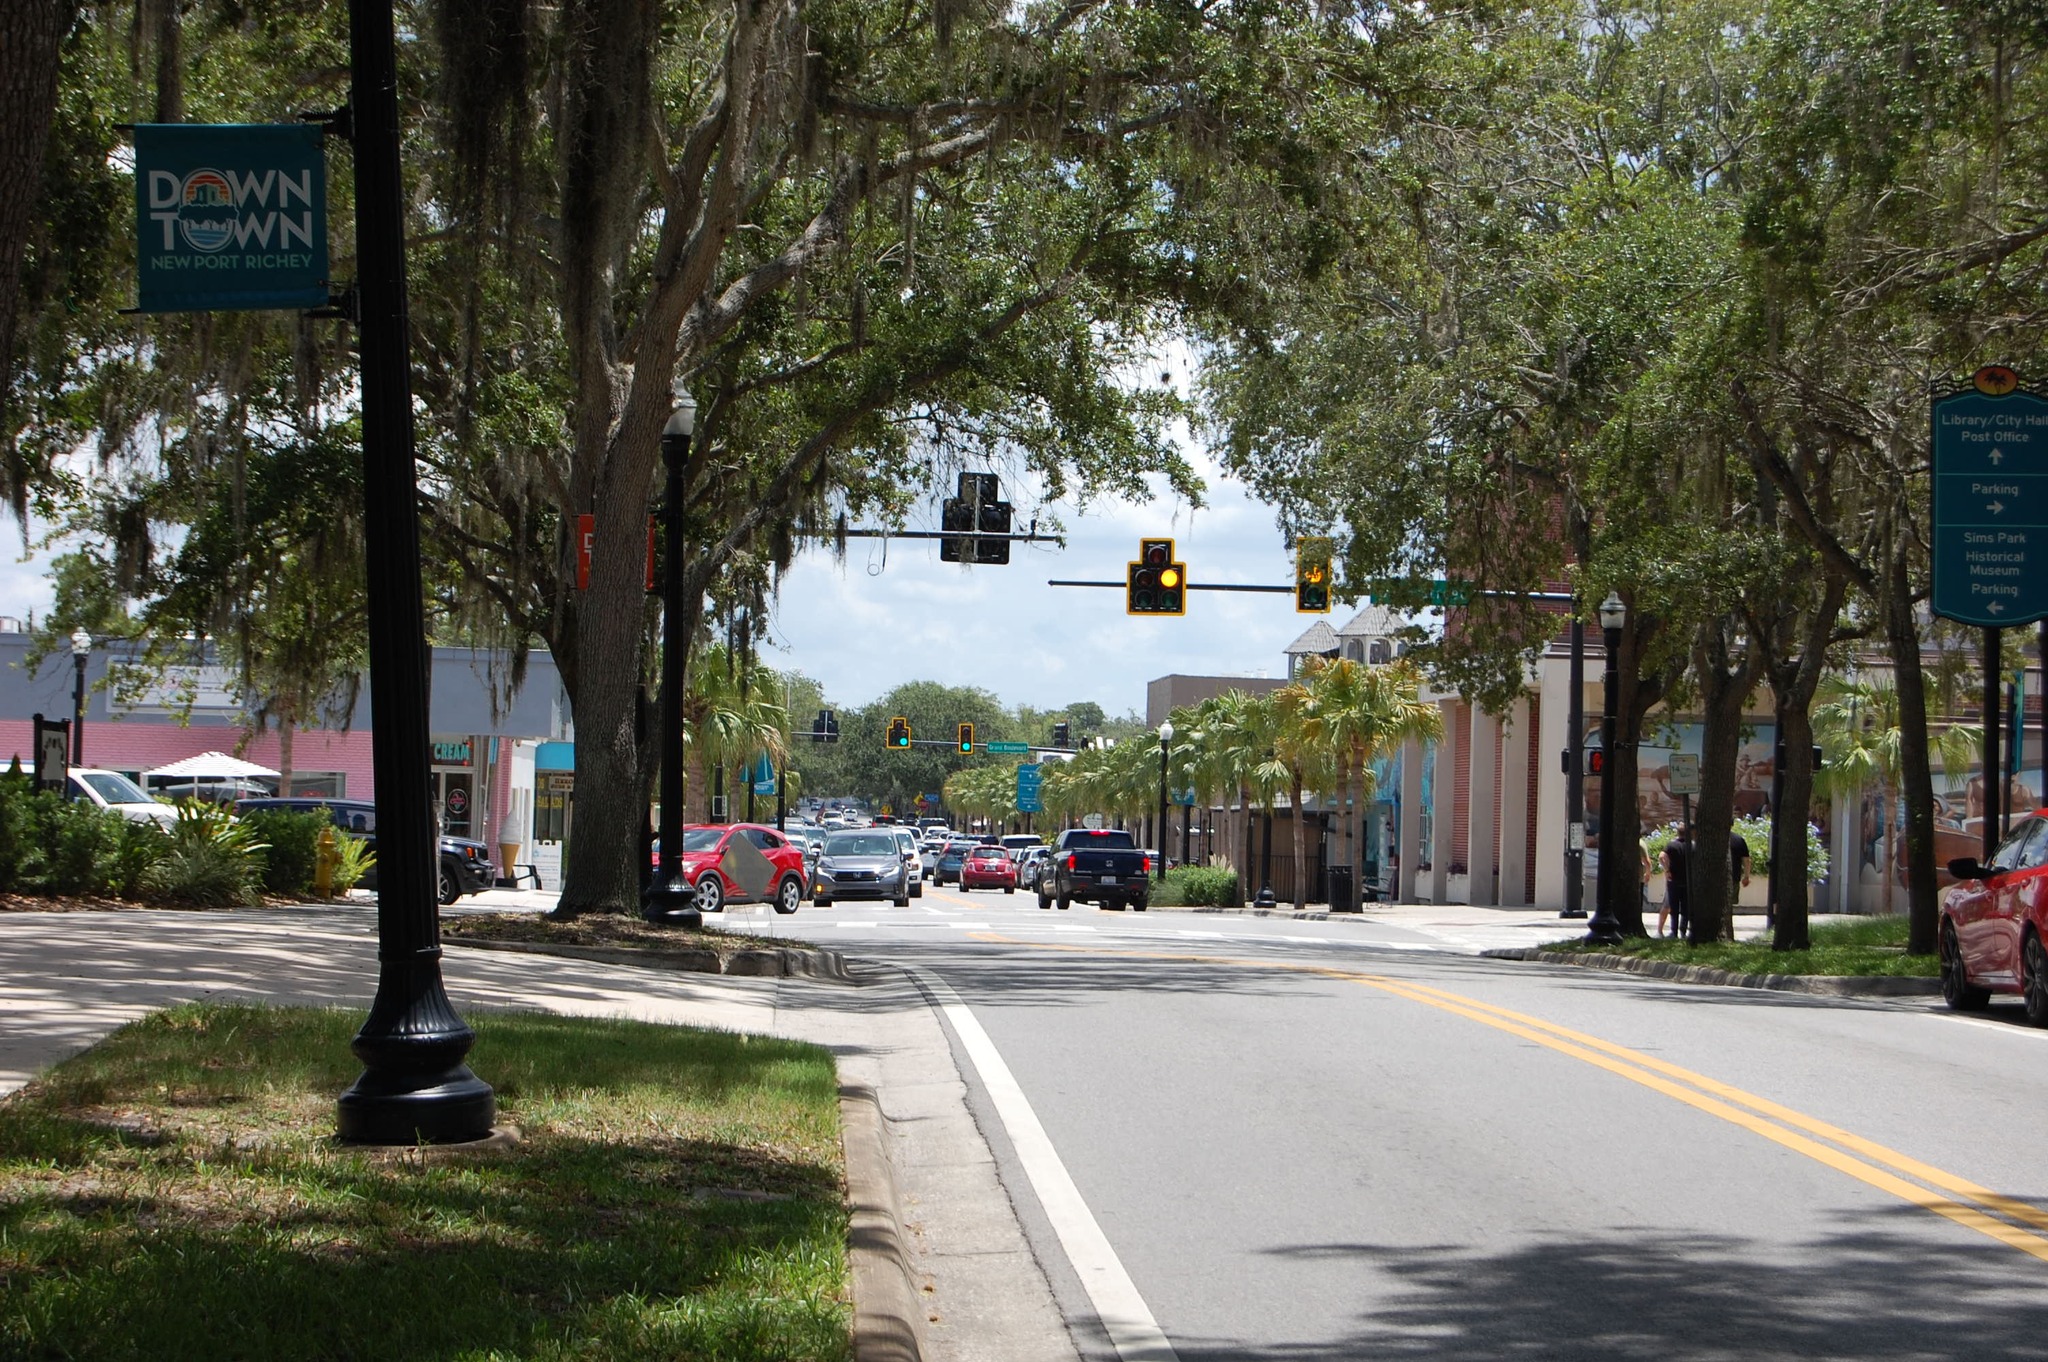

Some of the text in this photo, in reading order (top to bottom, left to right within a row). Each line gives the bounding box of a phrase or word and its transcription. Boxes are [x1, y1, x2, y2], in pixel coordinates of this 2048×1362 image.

[149, 168, 312, 209] DOWN
[149, 211, 313, 252] TOWN
[151, 253, 312, 270] NEW PORT RICHEY
[1942, 414, 2048, 428] Library/City Hall
[1962, 431, 2029, 442] Post Office
[1972, 483, 2018, 497] Parking
[1964, 532, 2026, 544] Sims Park
[1966, 550, 2024, 562] Historical
[1970, 565, 2020, 576] Museum
[1971, 583, 2018, 598] Parking
[434, 743, 470, 760] CREAM
